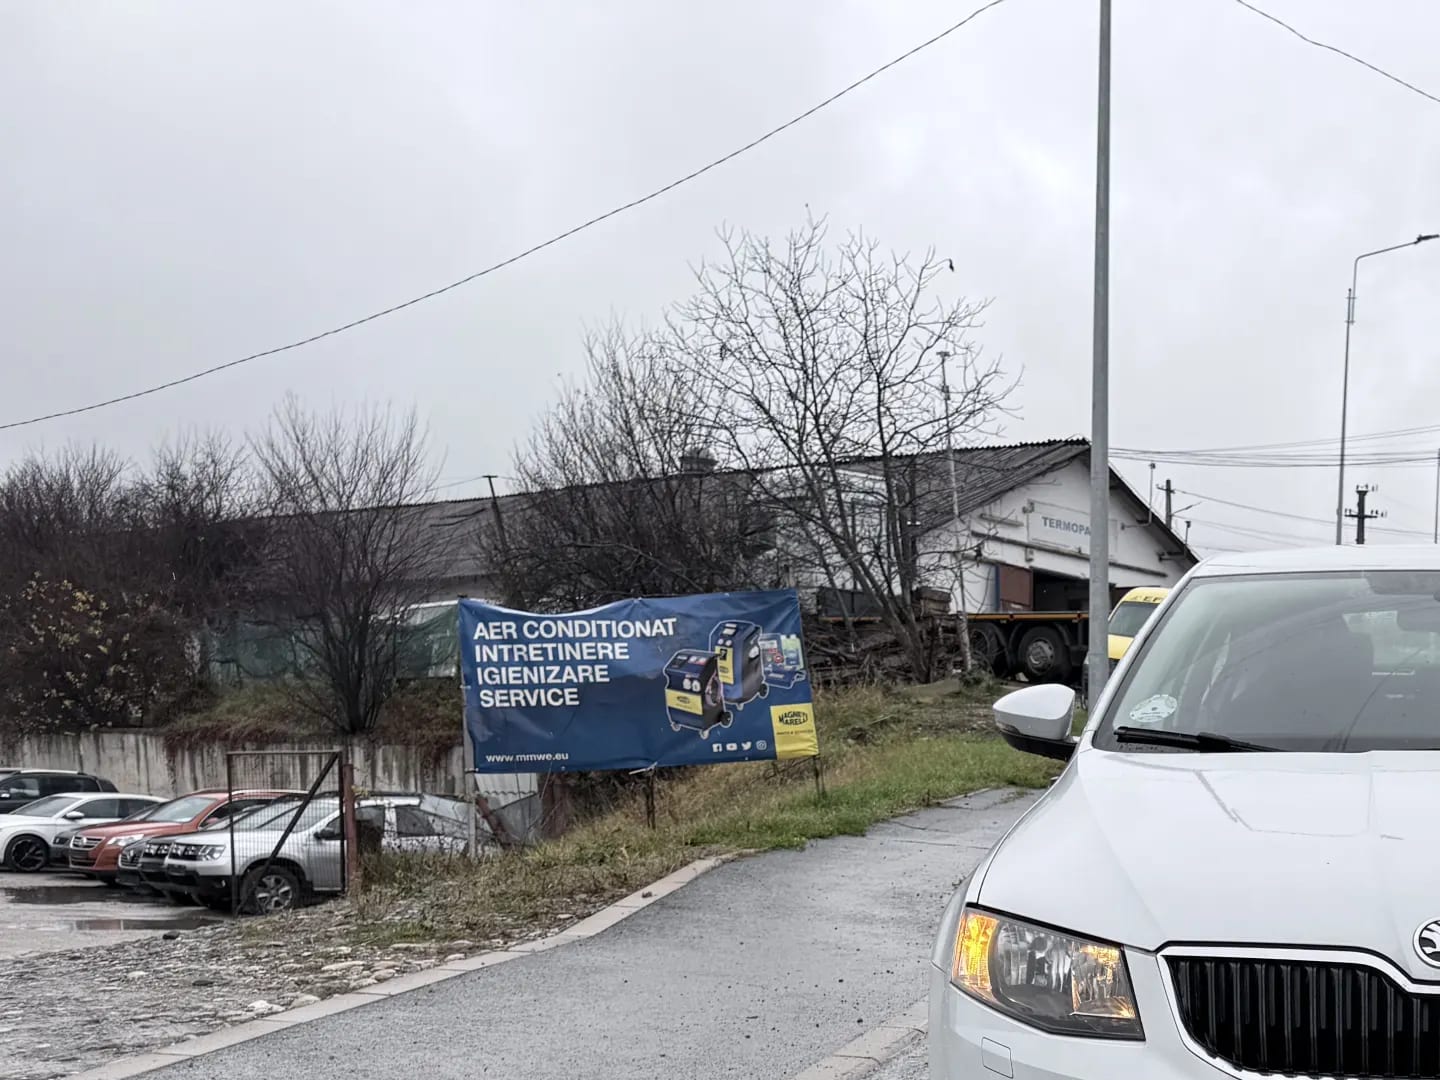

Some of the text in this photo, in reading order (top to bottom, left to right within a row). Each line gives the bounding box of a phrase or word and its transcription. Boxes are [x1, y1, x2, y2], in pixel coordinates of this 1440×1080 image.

[1041, 516, 1091, 536] TERMOPA
[473, 618, 677, 640] AER CONDITIONAT
[475, 642, 630, 663] INTRETINERE
[477, 664, 611, 685] IGIENIZARE
[480, 687, 580, 708] SERVICE
[486, 752, 569, 763] www.mmwe.eu
